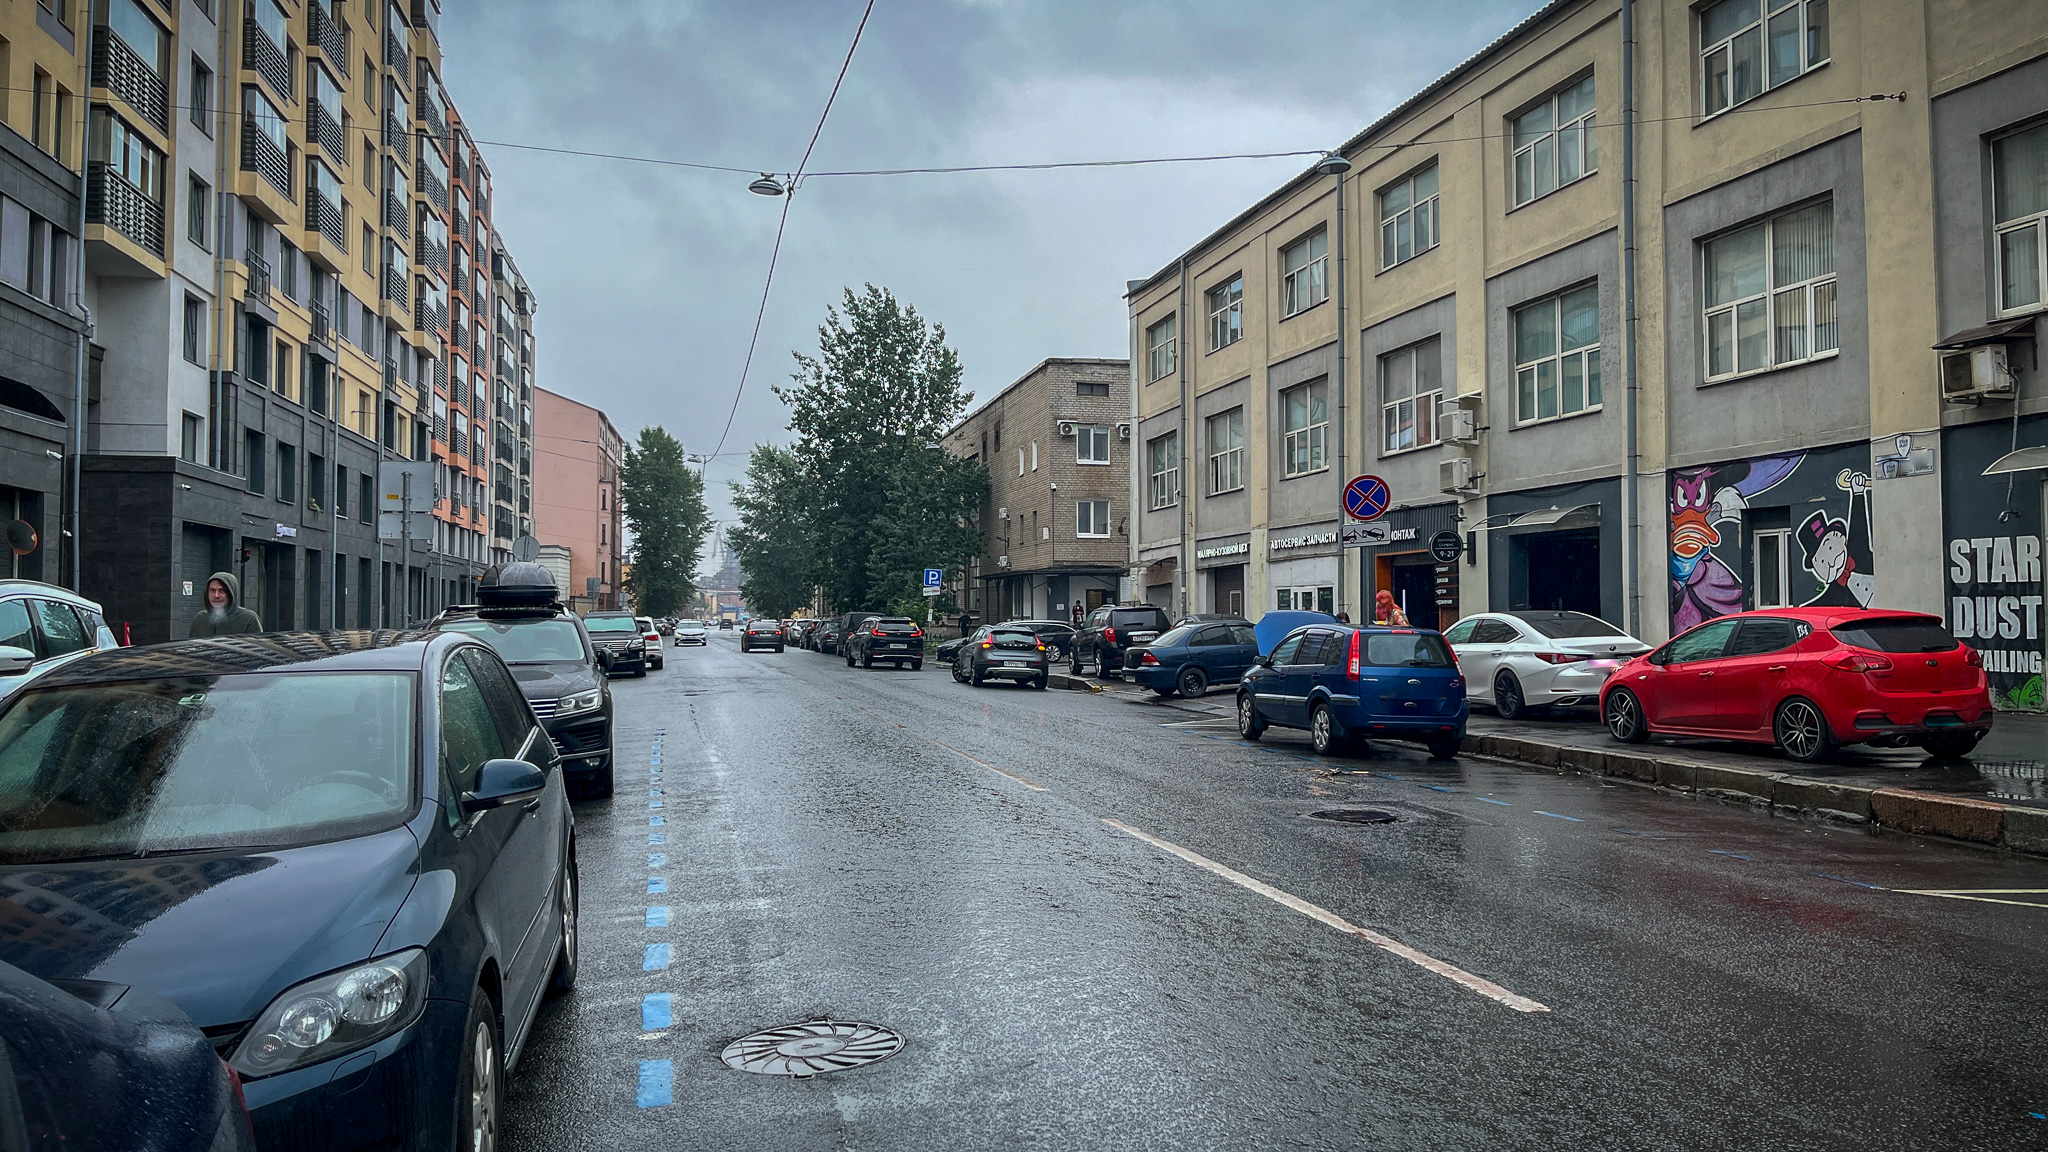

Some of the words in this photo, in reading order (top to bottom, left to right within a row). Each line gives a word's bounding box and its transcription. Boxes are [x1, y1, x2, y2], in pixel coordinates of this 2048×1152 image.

[1270, 537, 1306, 550] АВТОСЕРВИС
[1306, 531, 1337, 545] ЗАПЧАСТИ
[1197, 542, 1239, 559] МАЛЯРНО-КУЗОВНОЙ
[1238, 542, 1248, 554] ЦЕХ
[1439, 550, 1454, 558] 9-21
[1949, 535, 2041, 584] STAR
[1952, 595, 2043, 640] DUST
